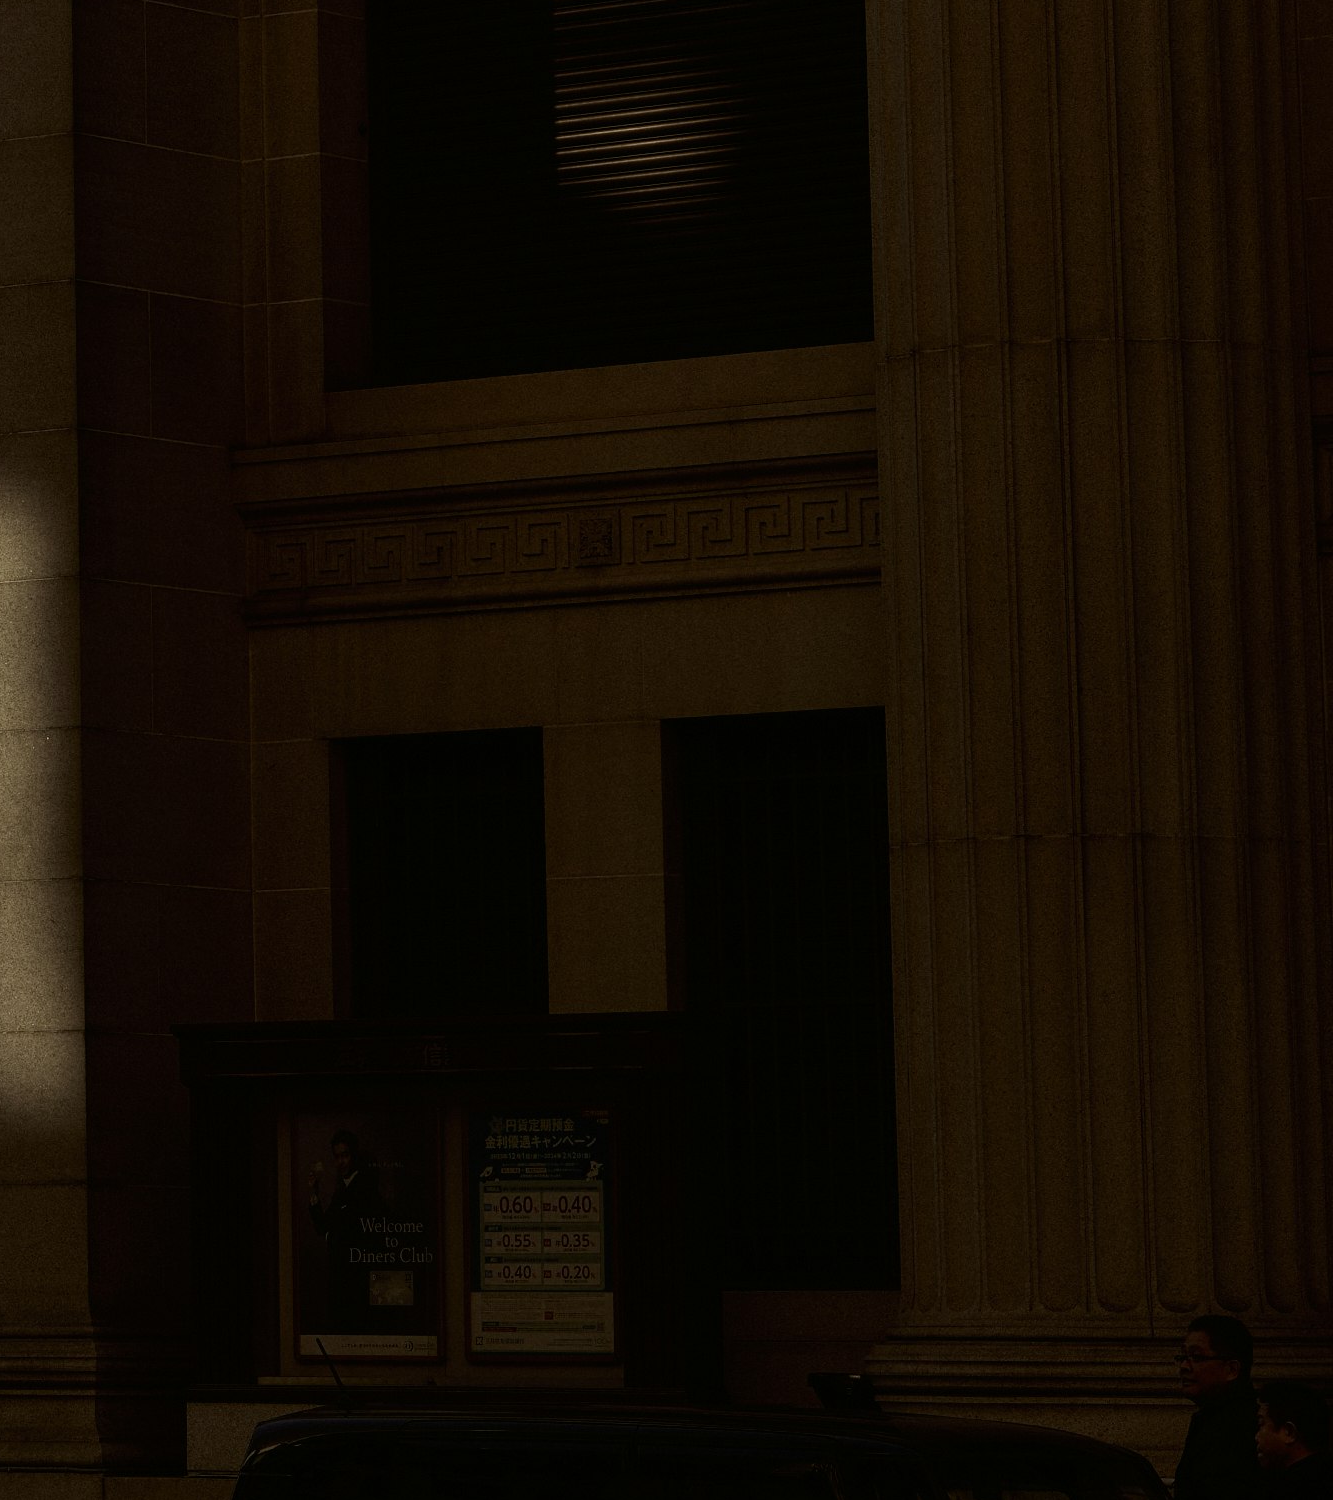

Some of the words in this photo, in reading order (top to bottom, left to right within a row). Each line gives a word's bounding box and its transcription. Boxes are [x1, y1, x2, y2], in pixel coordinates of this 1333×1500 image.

[484, 1135, 597, 1149] 金利優遇キャンペーン
[359, 1216, 424, 1233] Welcome
[385, 1236, 399, 1248] to
[349, 1247, 396, 1263] Diners
[399, 1246, 434, 1263] Club
